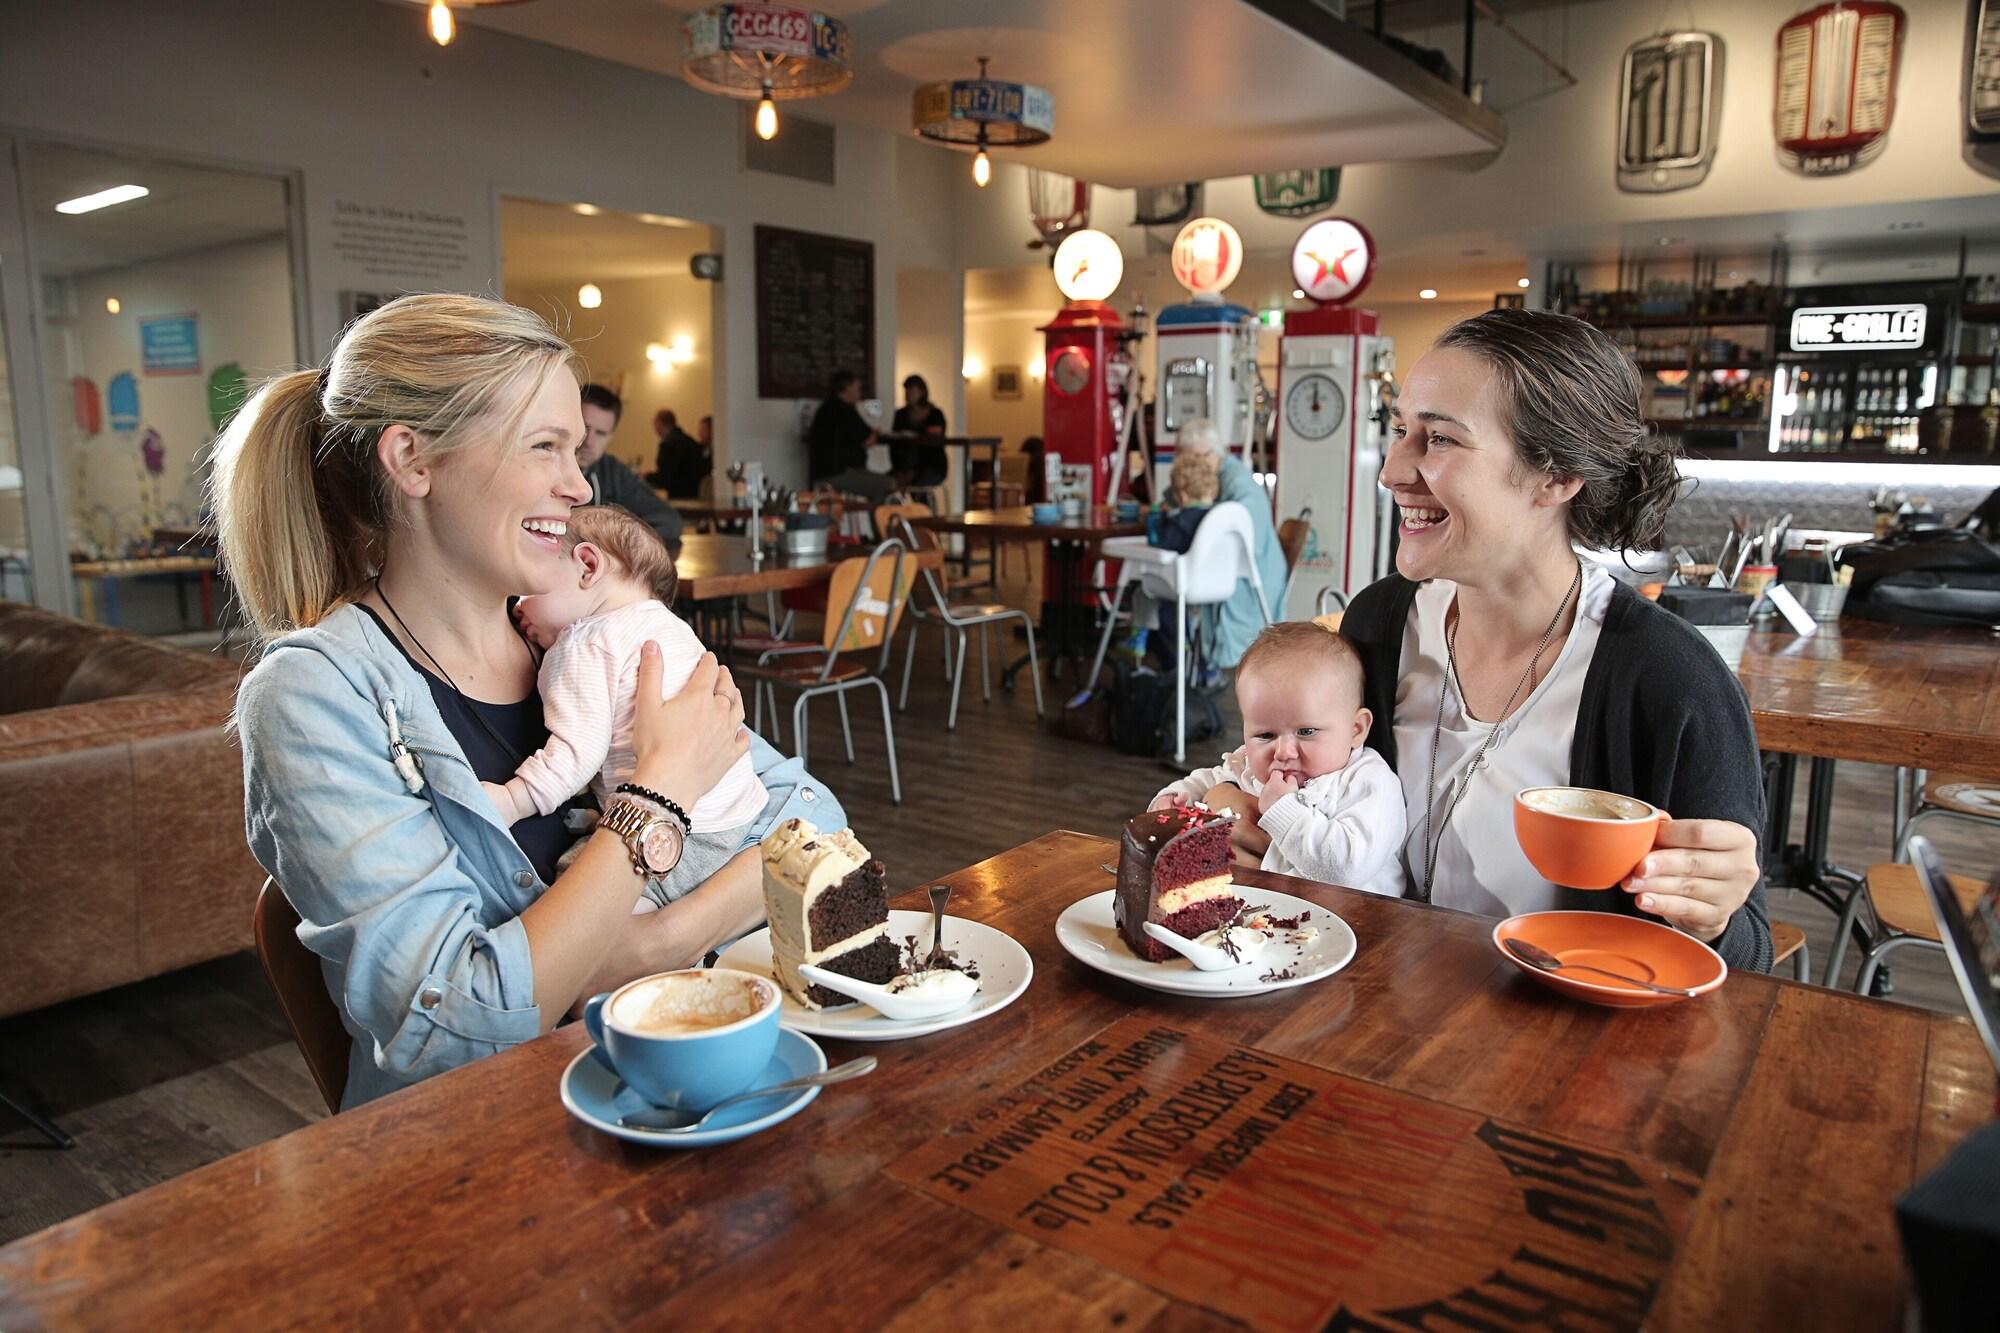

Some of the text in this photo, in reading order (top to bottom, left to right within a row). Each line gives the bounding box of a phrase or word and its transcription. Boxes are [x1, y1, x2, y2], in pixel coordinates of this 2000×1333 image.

[929, 1026, 1190, 1193] HIGHLY INFLAMMABLE
[1070, 1085, 1151, 1143] AGENTS
[1083, 1154, 1147, 1182] &
[1181, 1115, 1280, 1183] IMPERIAL
